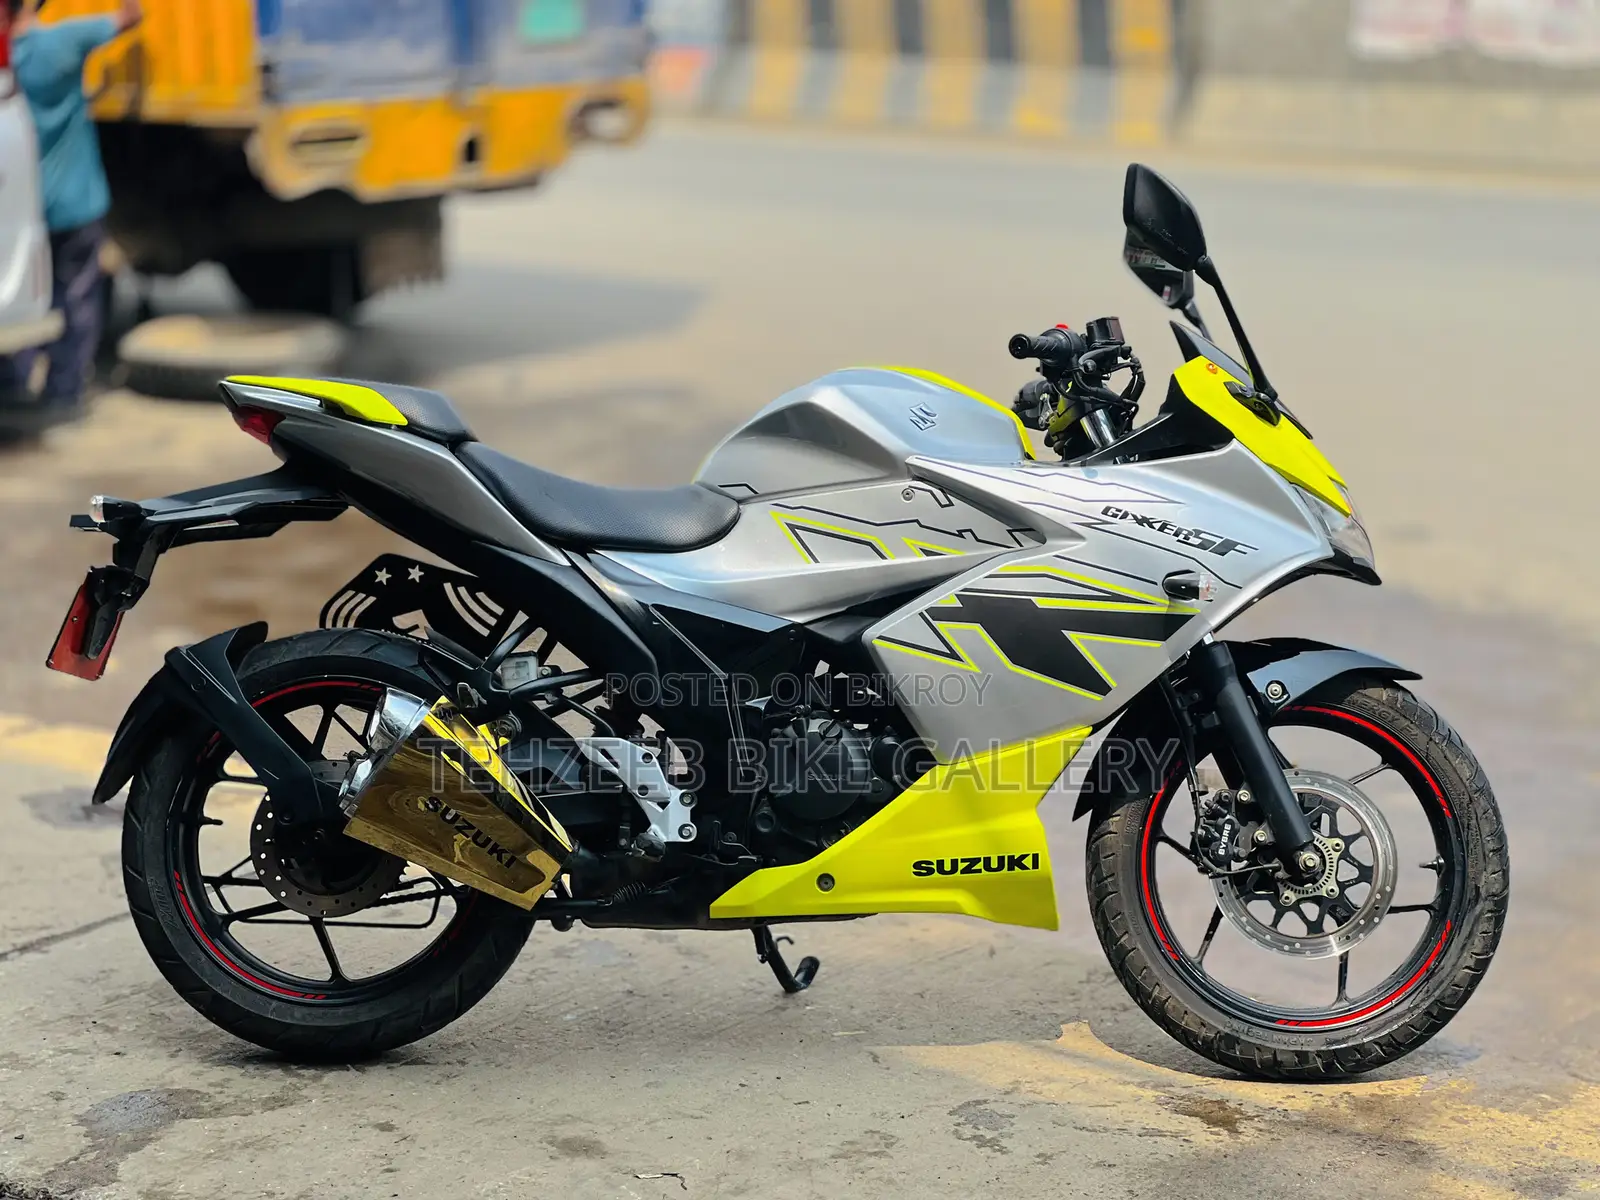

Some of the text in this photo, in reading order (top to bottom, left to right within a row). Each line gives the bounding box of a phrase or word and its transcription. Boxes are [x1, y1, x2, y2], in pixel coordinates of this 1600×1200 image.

[1101, 505, 1259, 557] GIXXER SF
[424, 796, 517, 869] SUZUKI
[1218, 823, 1232, 855] BYBRE
[912, 853, 1040, 877] SUZUKI
